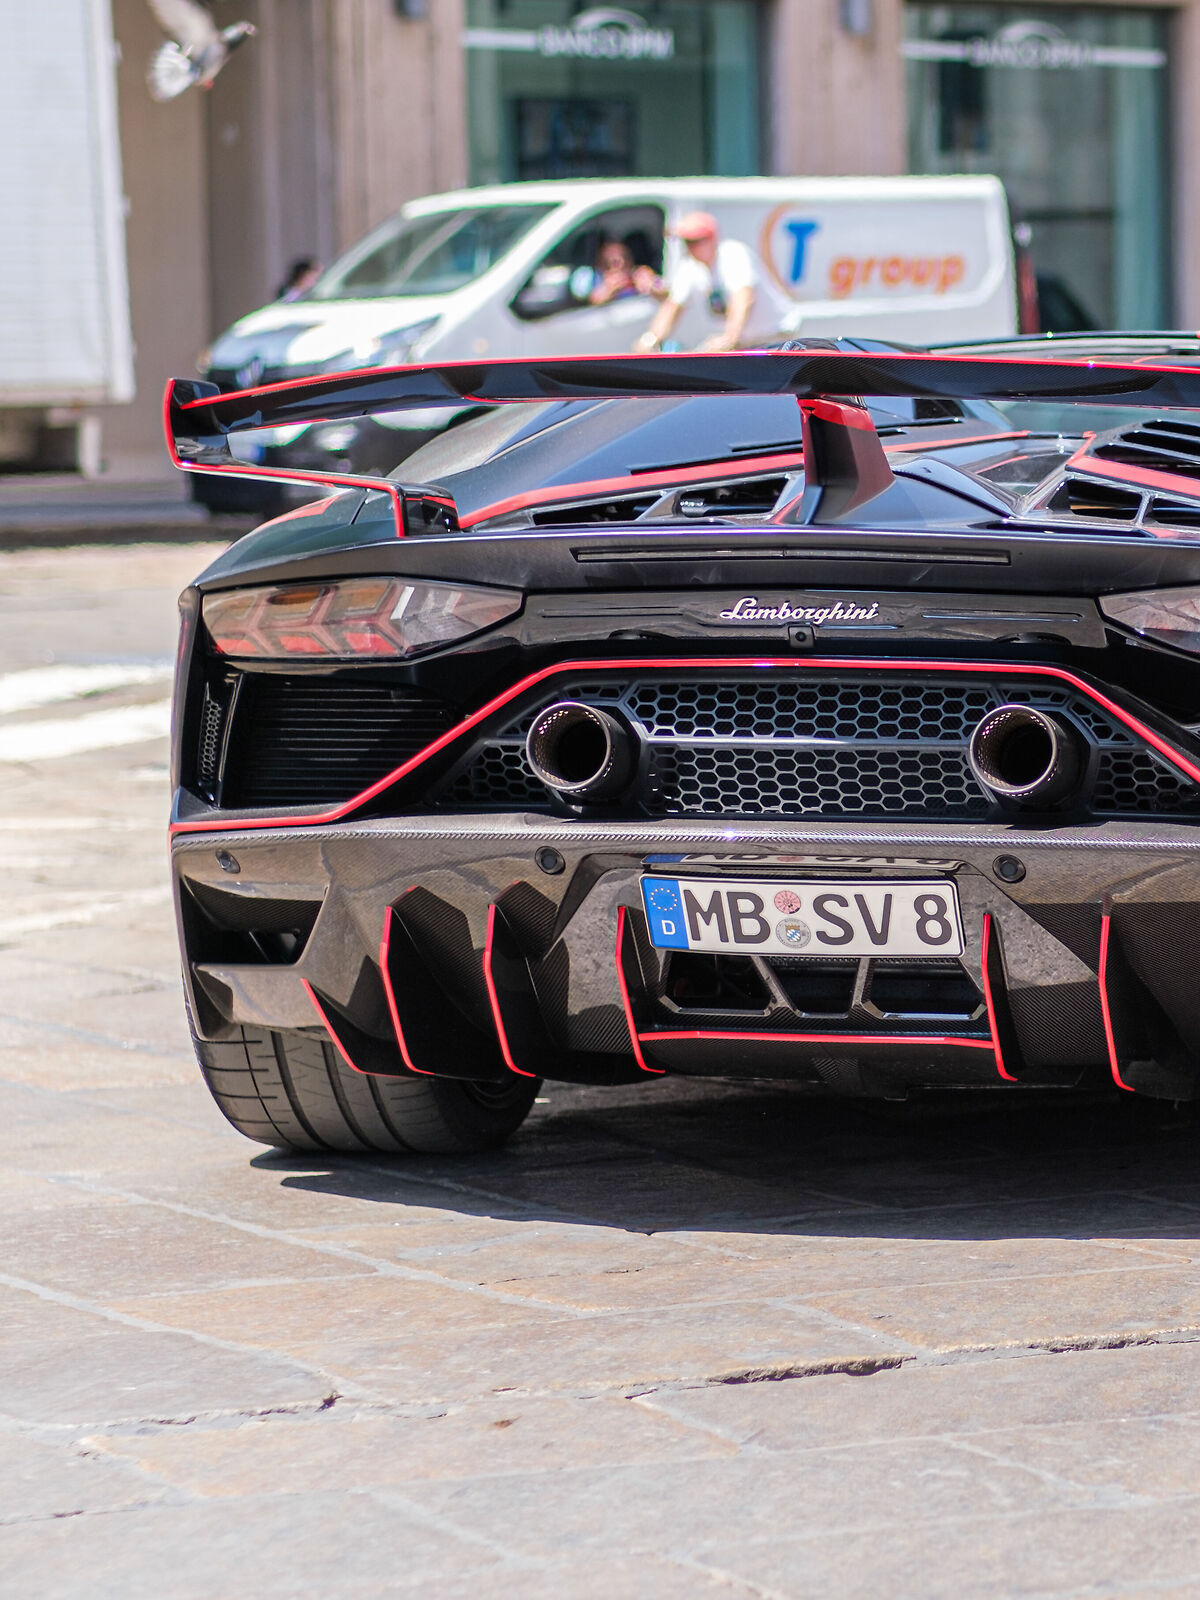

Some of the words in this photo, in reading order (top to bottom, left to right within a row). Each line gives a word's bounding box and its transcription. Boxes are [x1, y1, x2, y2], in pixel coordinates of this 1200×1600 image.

[830, 254, 966, 300] group
[719, 596, 879, 625] Lamborghini
[661, 919, 676, 935] D
[683, 889, 771, 945] MB
[812, 893, 893, 946] SV
[913, 894, 952, 946] 8
